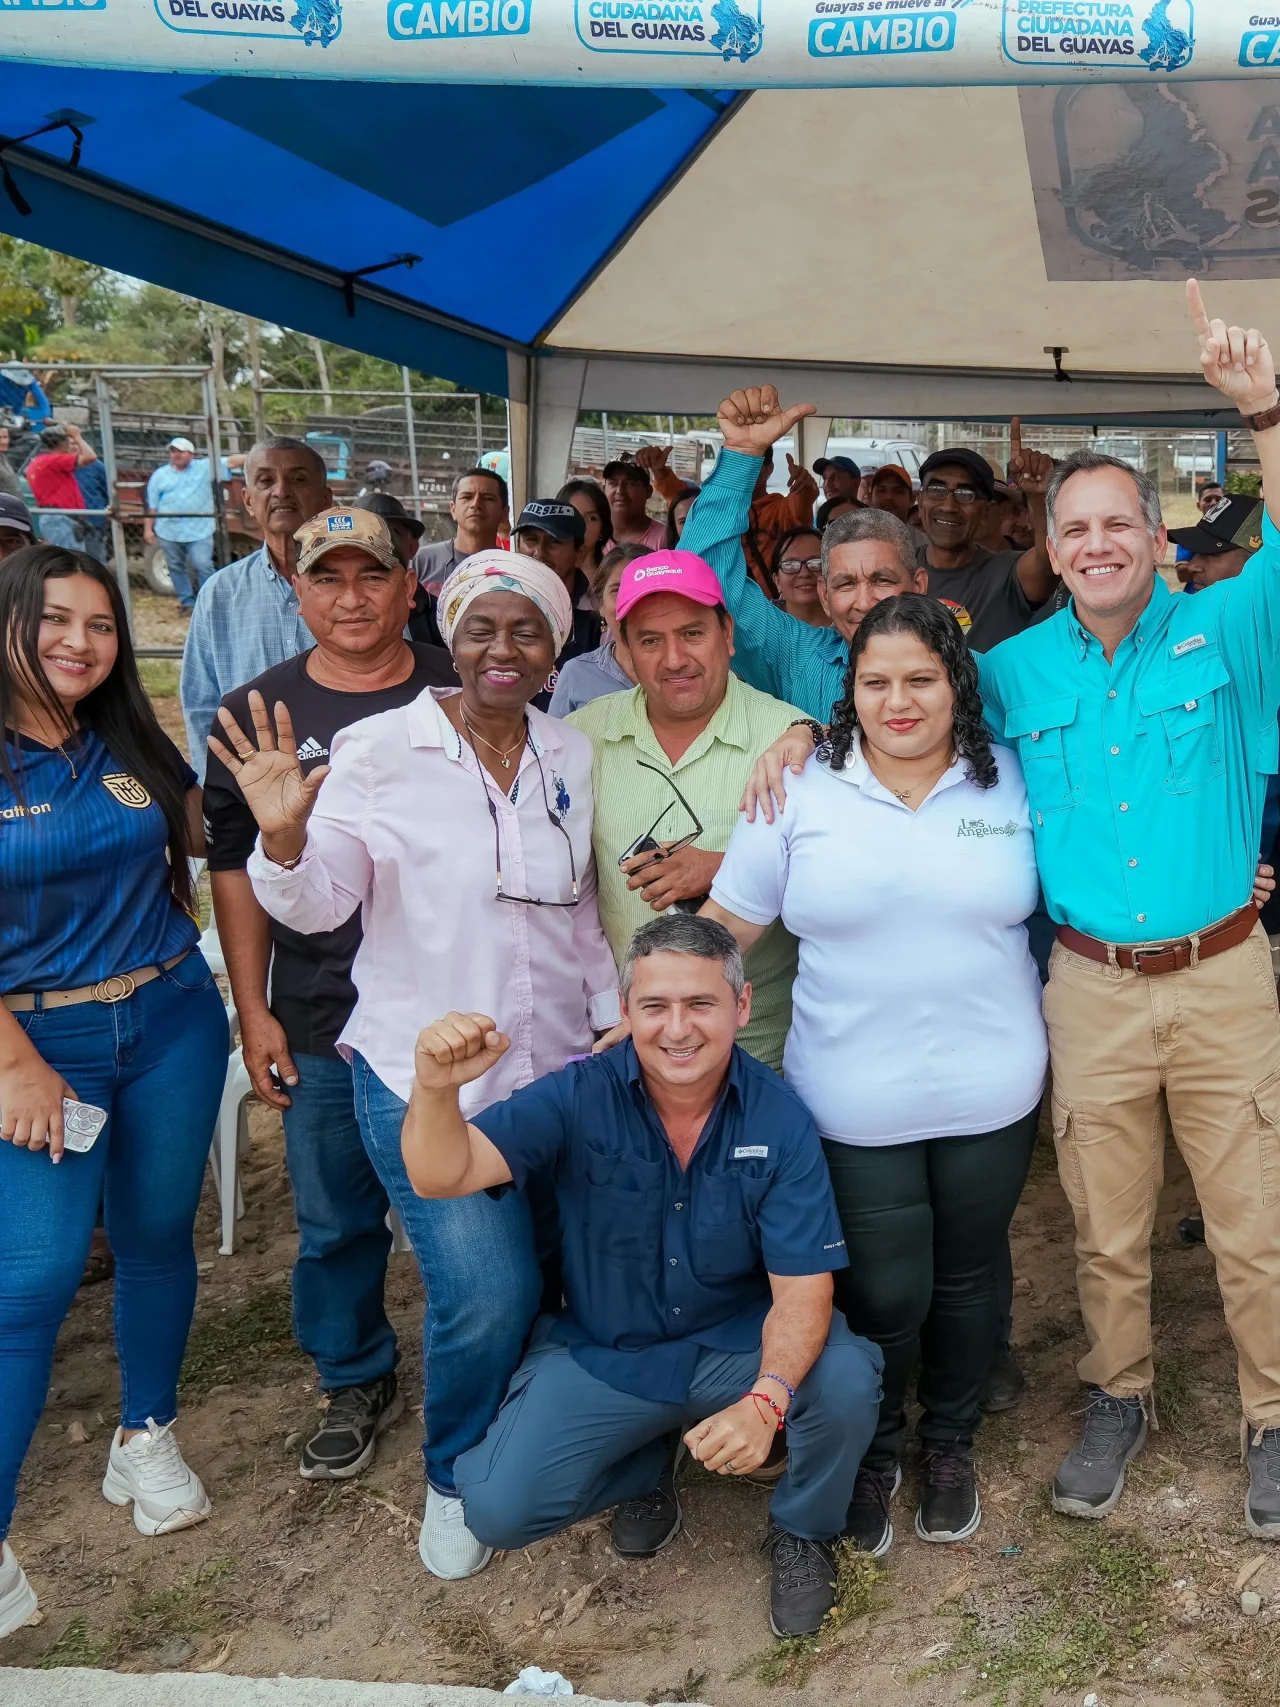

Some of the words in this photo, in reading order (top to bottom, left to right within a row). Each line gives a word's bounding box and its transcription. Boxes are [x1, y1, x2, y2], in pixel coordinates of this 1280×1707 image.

[170, 0, 208, 18] DEL
[211, 1, 285, 23] GUAYAS
[589, 1, 704, 22] CIUDADANA
[815, 1, 864, 14] Guayas
[867, 2, 882, 11] se
[885, 0, 930, 10] mueve
[1017, 0, 1134, 17] PREFECTURA
[393, 0, 525, 36] CAMBIO
[1016, 16, 1134, 37] CIUDADANA
[590, 20, 628, 38] DEL
[631, 22, 705, 42] GUAYAS
[814, 15, 950, 53] CAMBIO
[1017, 35, 1055, 53] DEL
[1059, 37, 1135, 55] GUAYAS
[296, 748, 329, 761] adidas
[960, 818, 985, 830] Los
